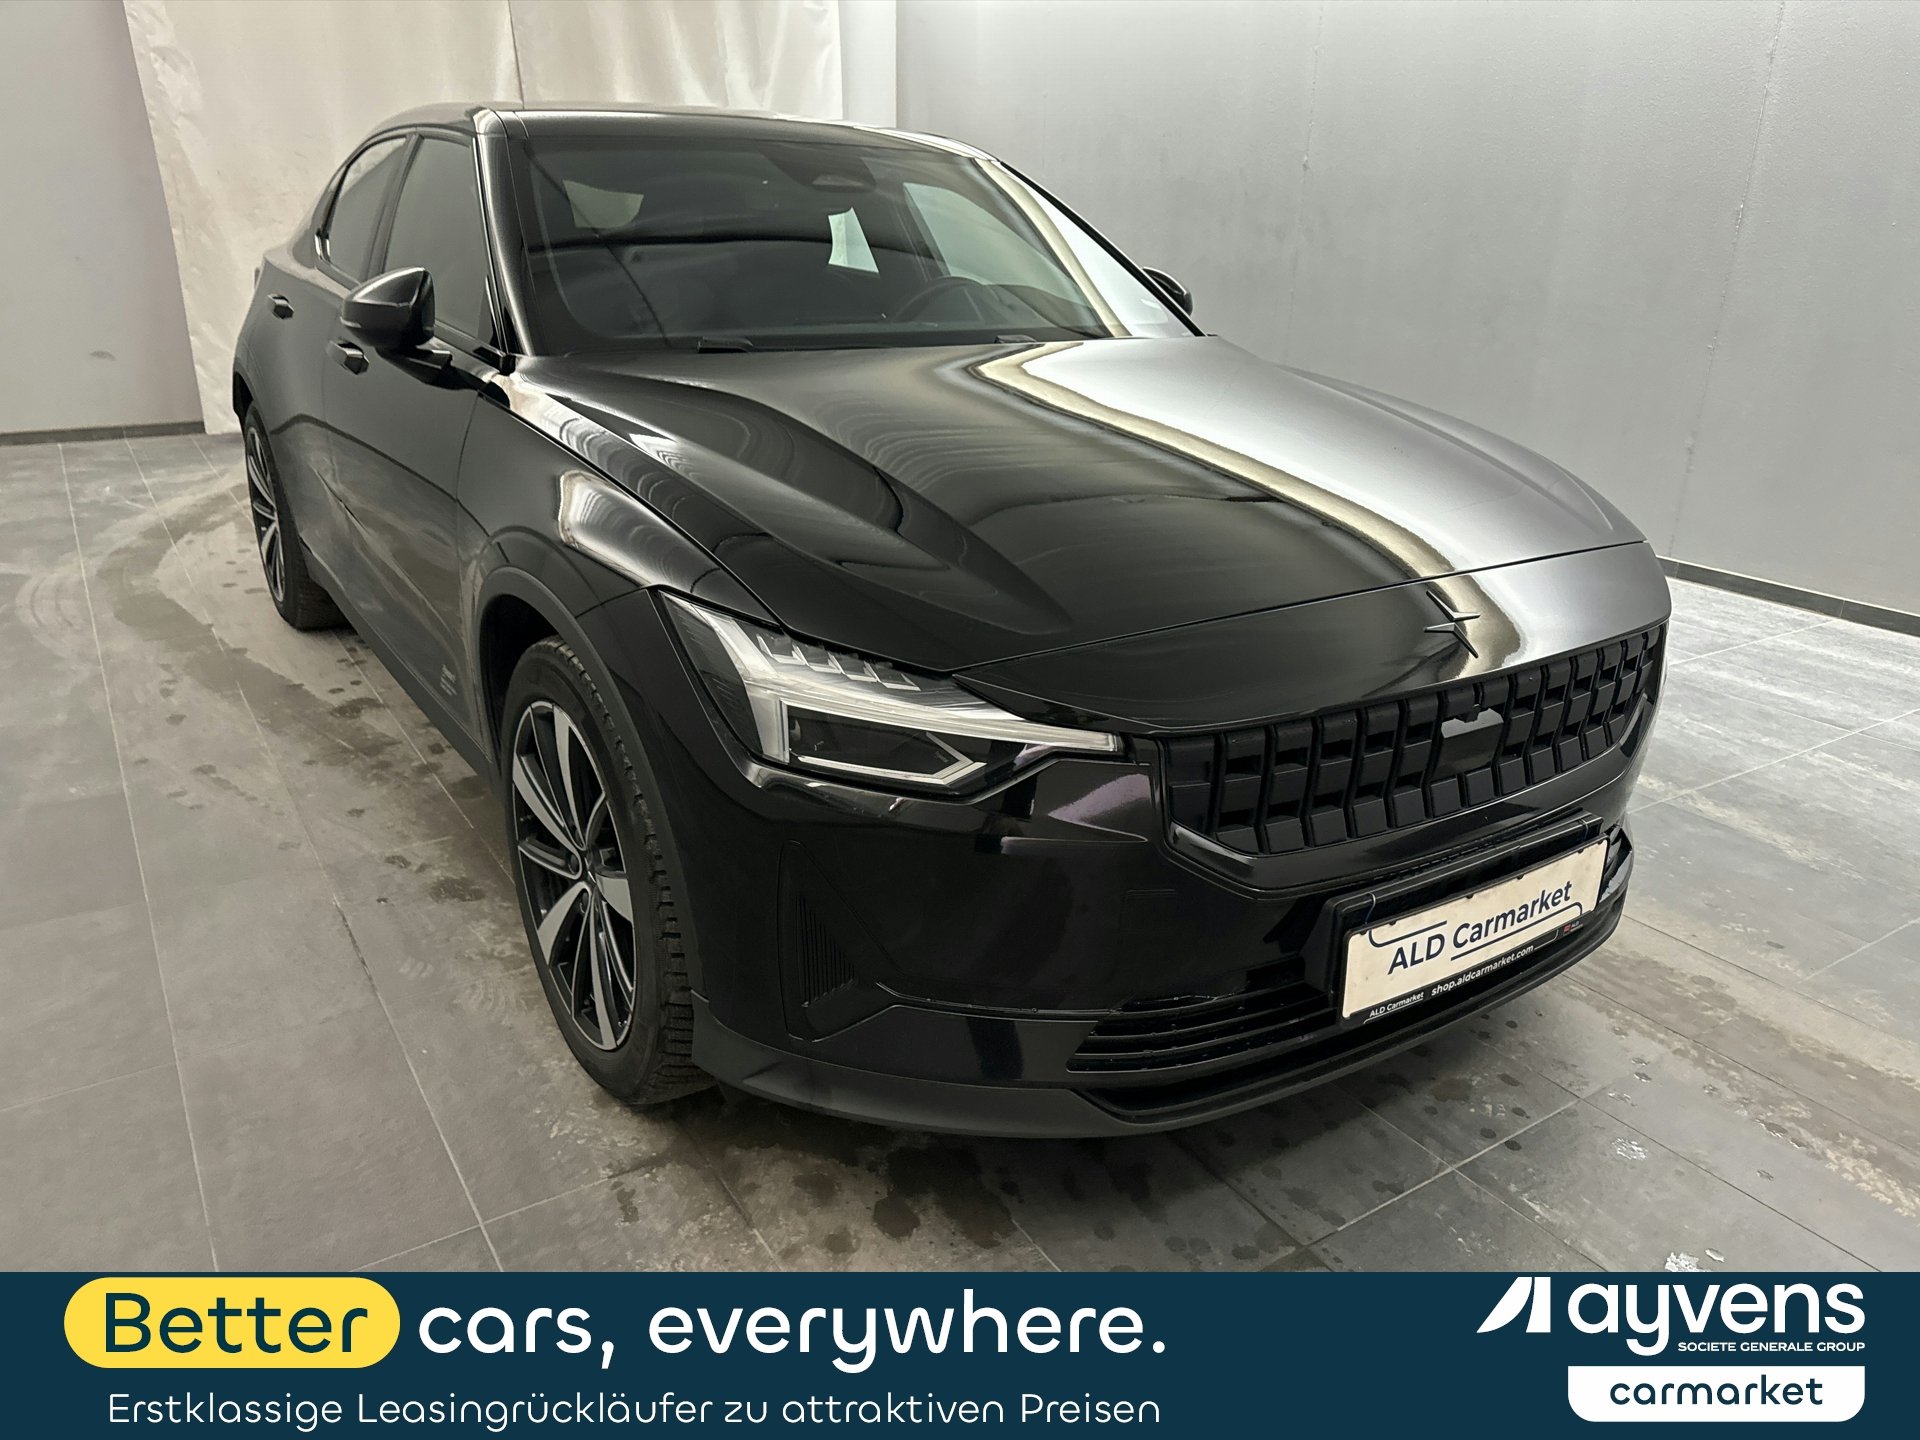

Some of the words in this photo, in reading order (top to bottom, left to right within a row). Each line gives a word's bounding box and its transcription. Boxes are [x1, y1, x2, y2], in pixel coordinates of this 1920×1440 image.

[1387, 932, 1445, 976] ALD
[1452, 880, 1572, 949] Carmarket
[1431, 943, 1534, 997] shop.aldcarmarket.com
[1369, 1006, 1386, 1018] ALD
[1386, 991, 1424, 1011] Carmarket
